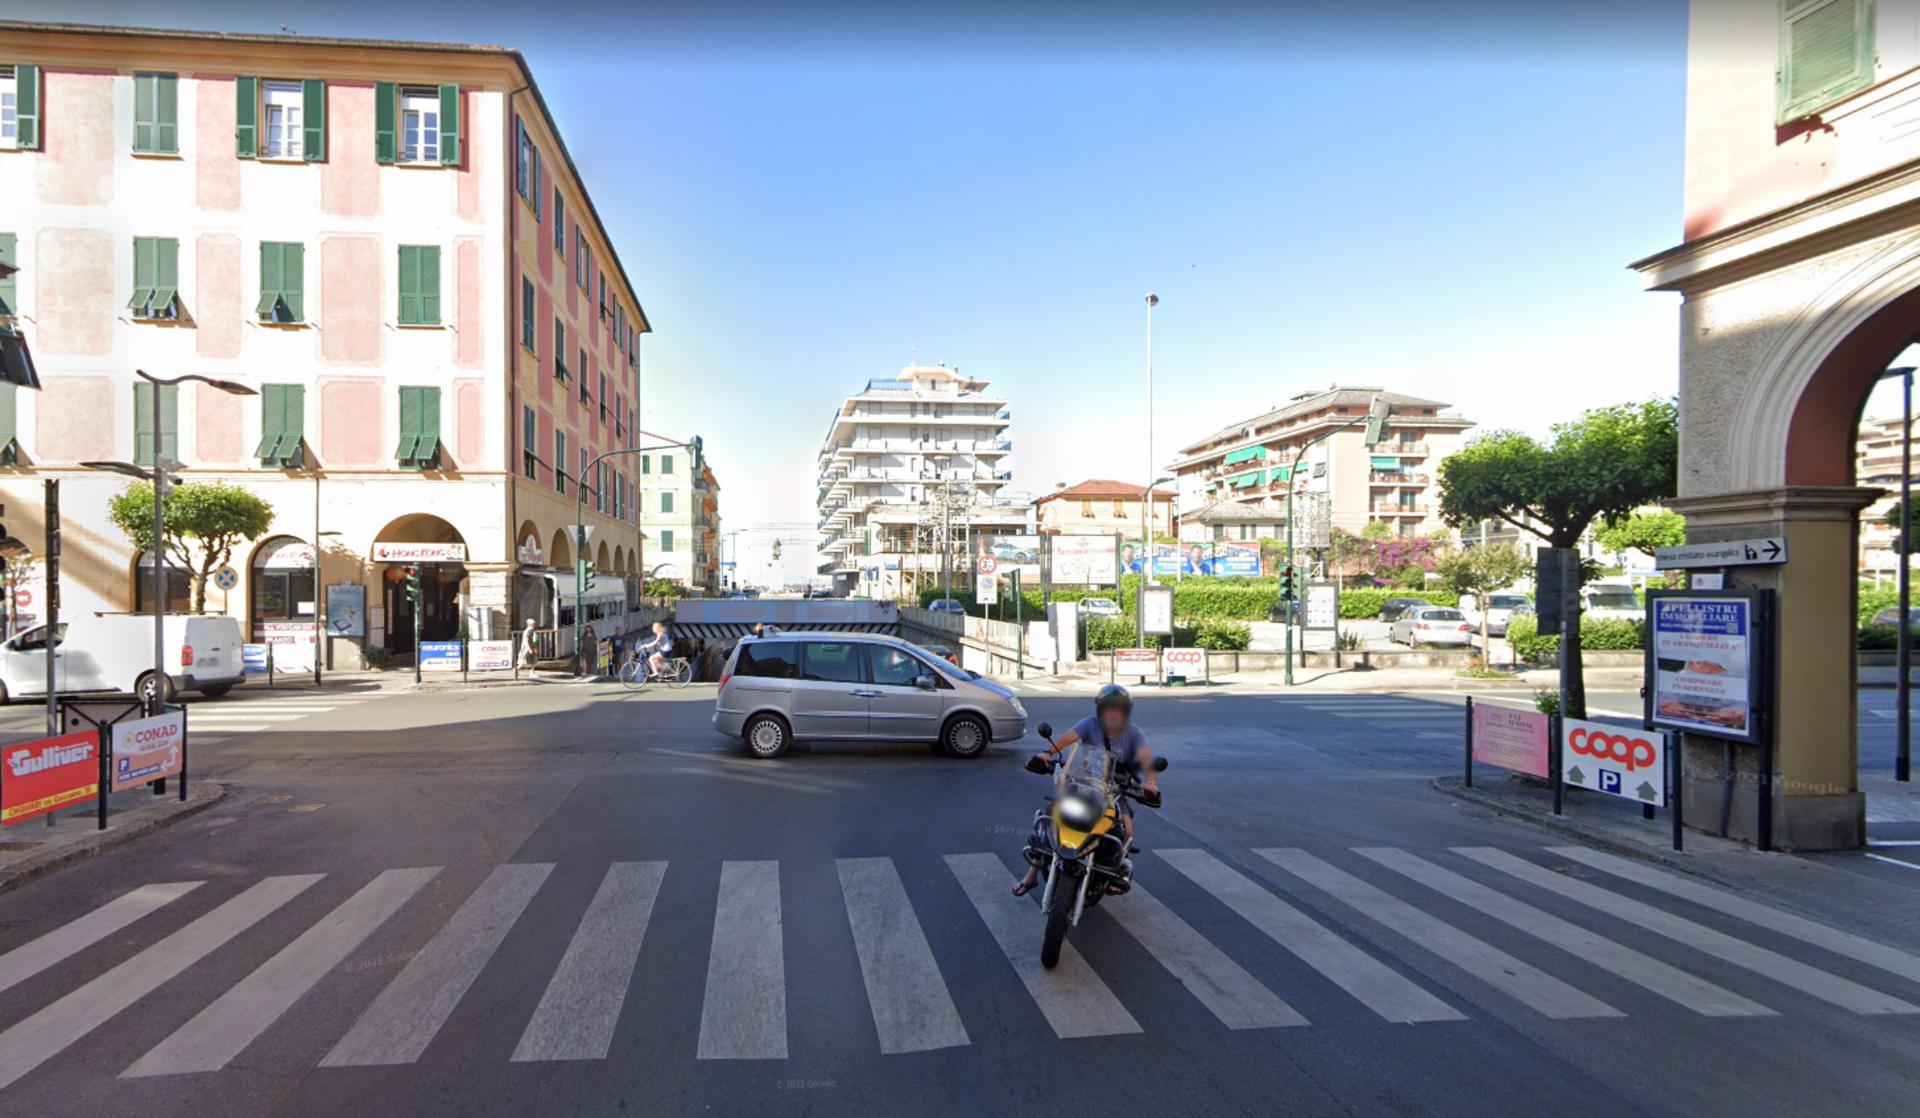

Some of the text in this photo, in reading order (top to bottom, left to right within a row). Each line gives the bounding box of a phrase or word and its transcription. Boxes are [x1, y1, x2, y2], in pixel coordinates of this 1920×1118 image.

[1660, 611, 1738, 622] IMMOBILIARE
[1670, 604, 1738, 614] PELLISTRI
[1167, 651, 1202, 665] coop
[135, 723, 178, 743] CONAD
[1568, 727, 1656, 771] coop
[8, 742, 94, 777] Gulliver
